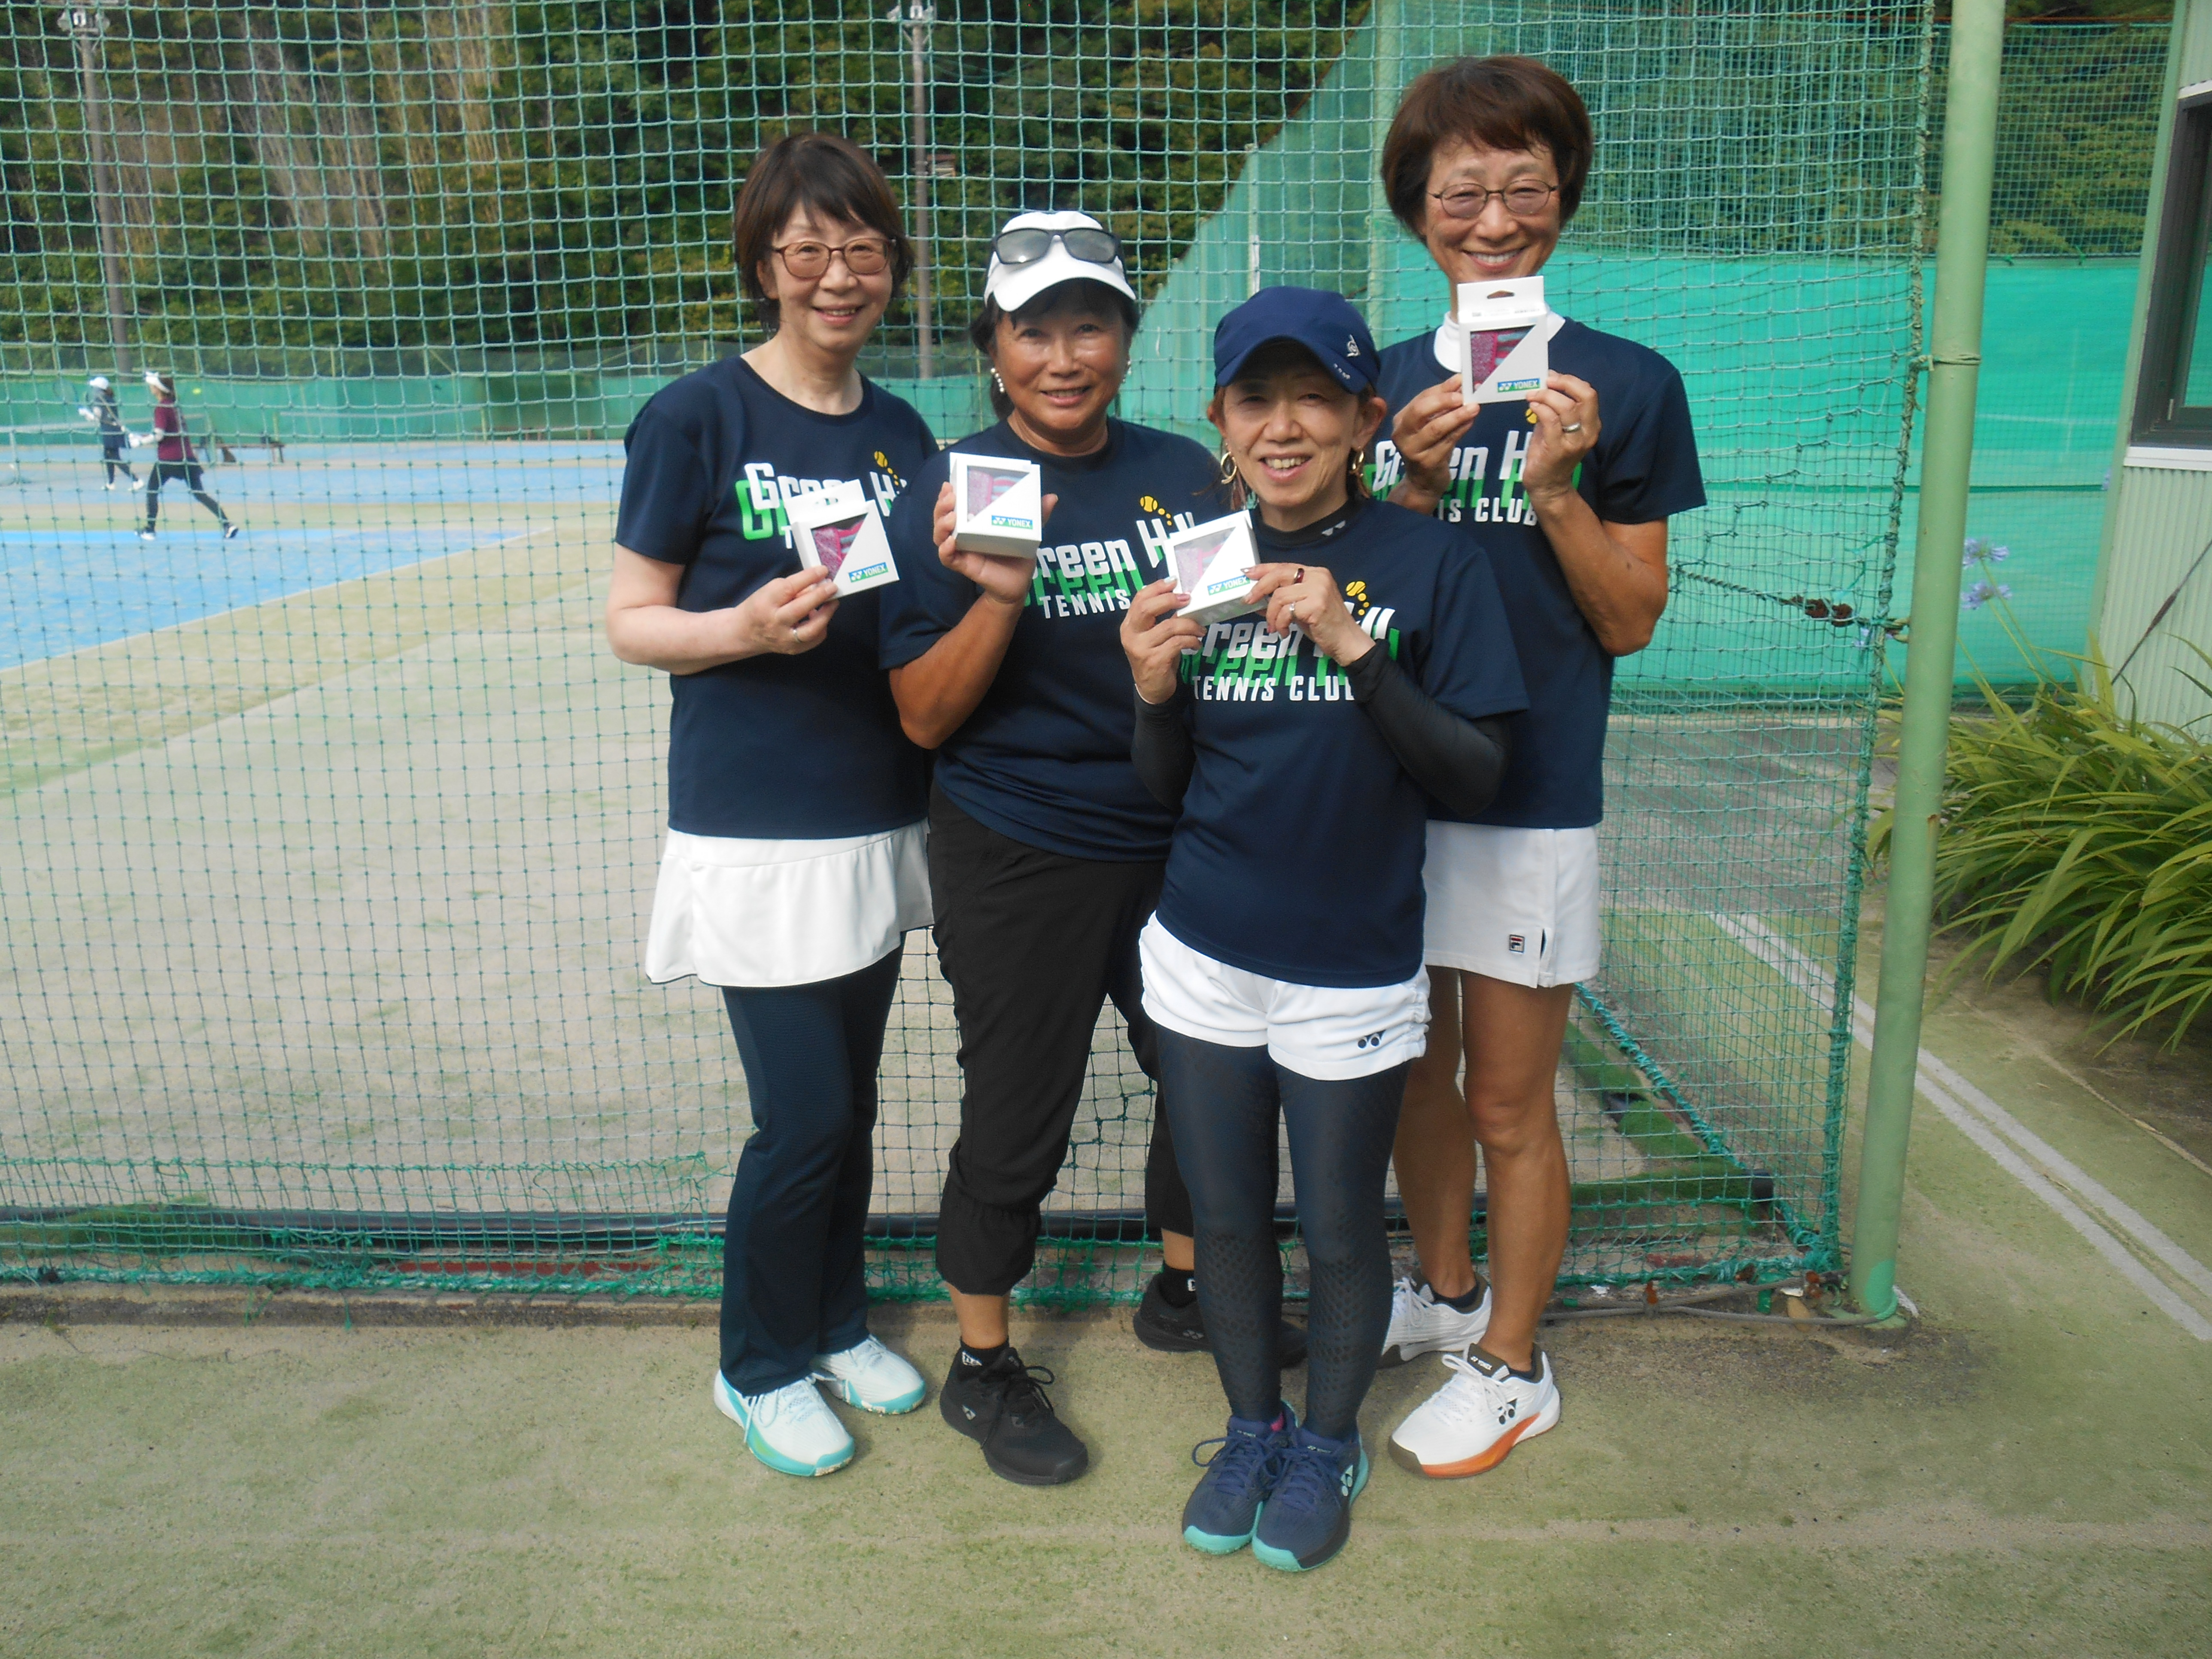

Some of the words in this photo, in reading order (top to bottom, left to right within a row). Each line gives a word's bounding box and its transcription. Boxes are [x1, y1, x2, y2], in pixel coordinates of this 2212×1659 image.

[1514, 380, 1538, 389] YONEX
[1007, 518, 1030, 528] YONEX
[1033, 539, 1136, 579] reen
[863, 563, 886, 577] YONEX
[1223, 576, 1248, 589] YONEX
[1039, 589, 1131, 619] TENNIS
[1181, 621, 1304, 659] reen
[1192, 675, 1276, 701] TENNIS
